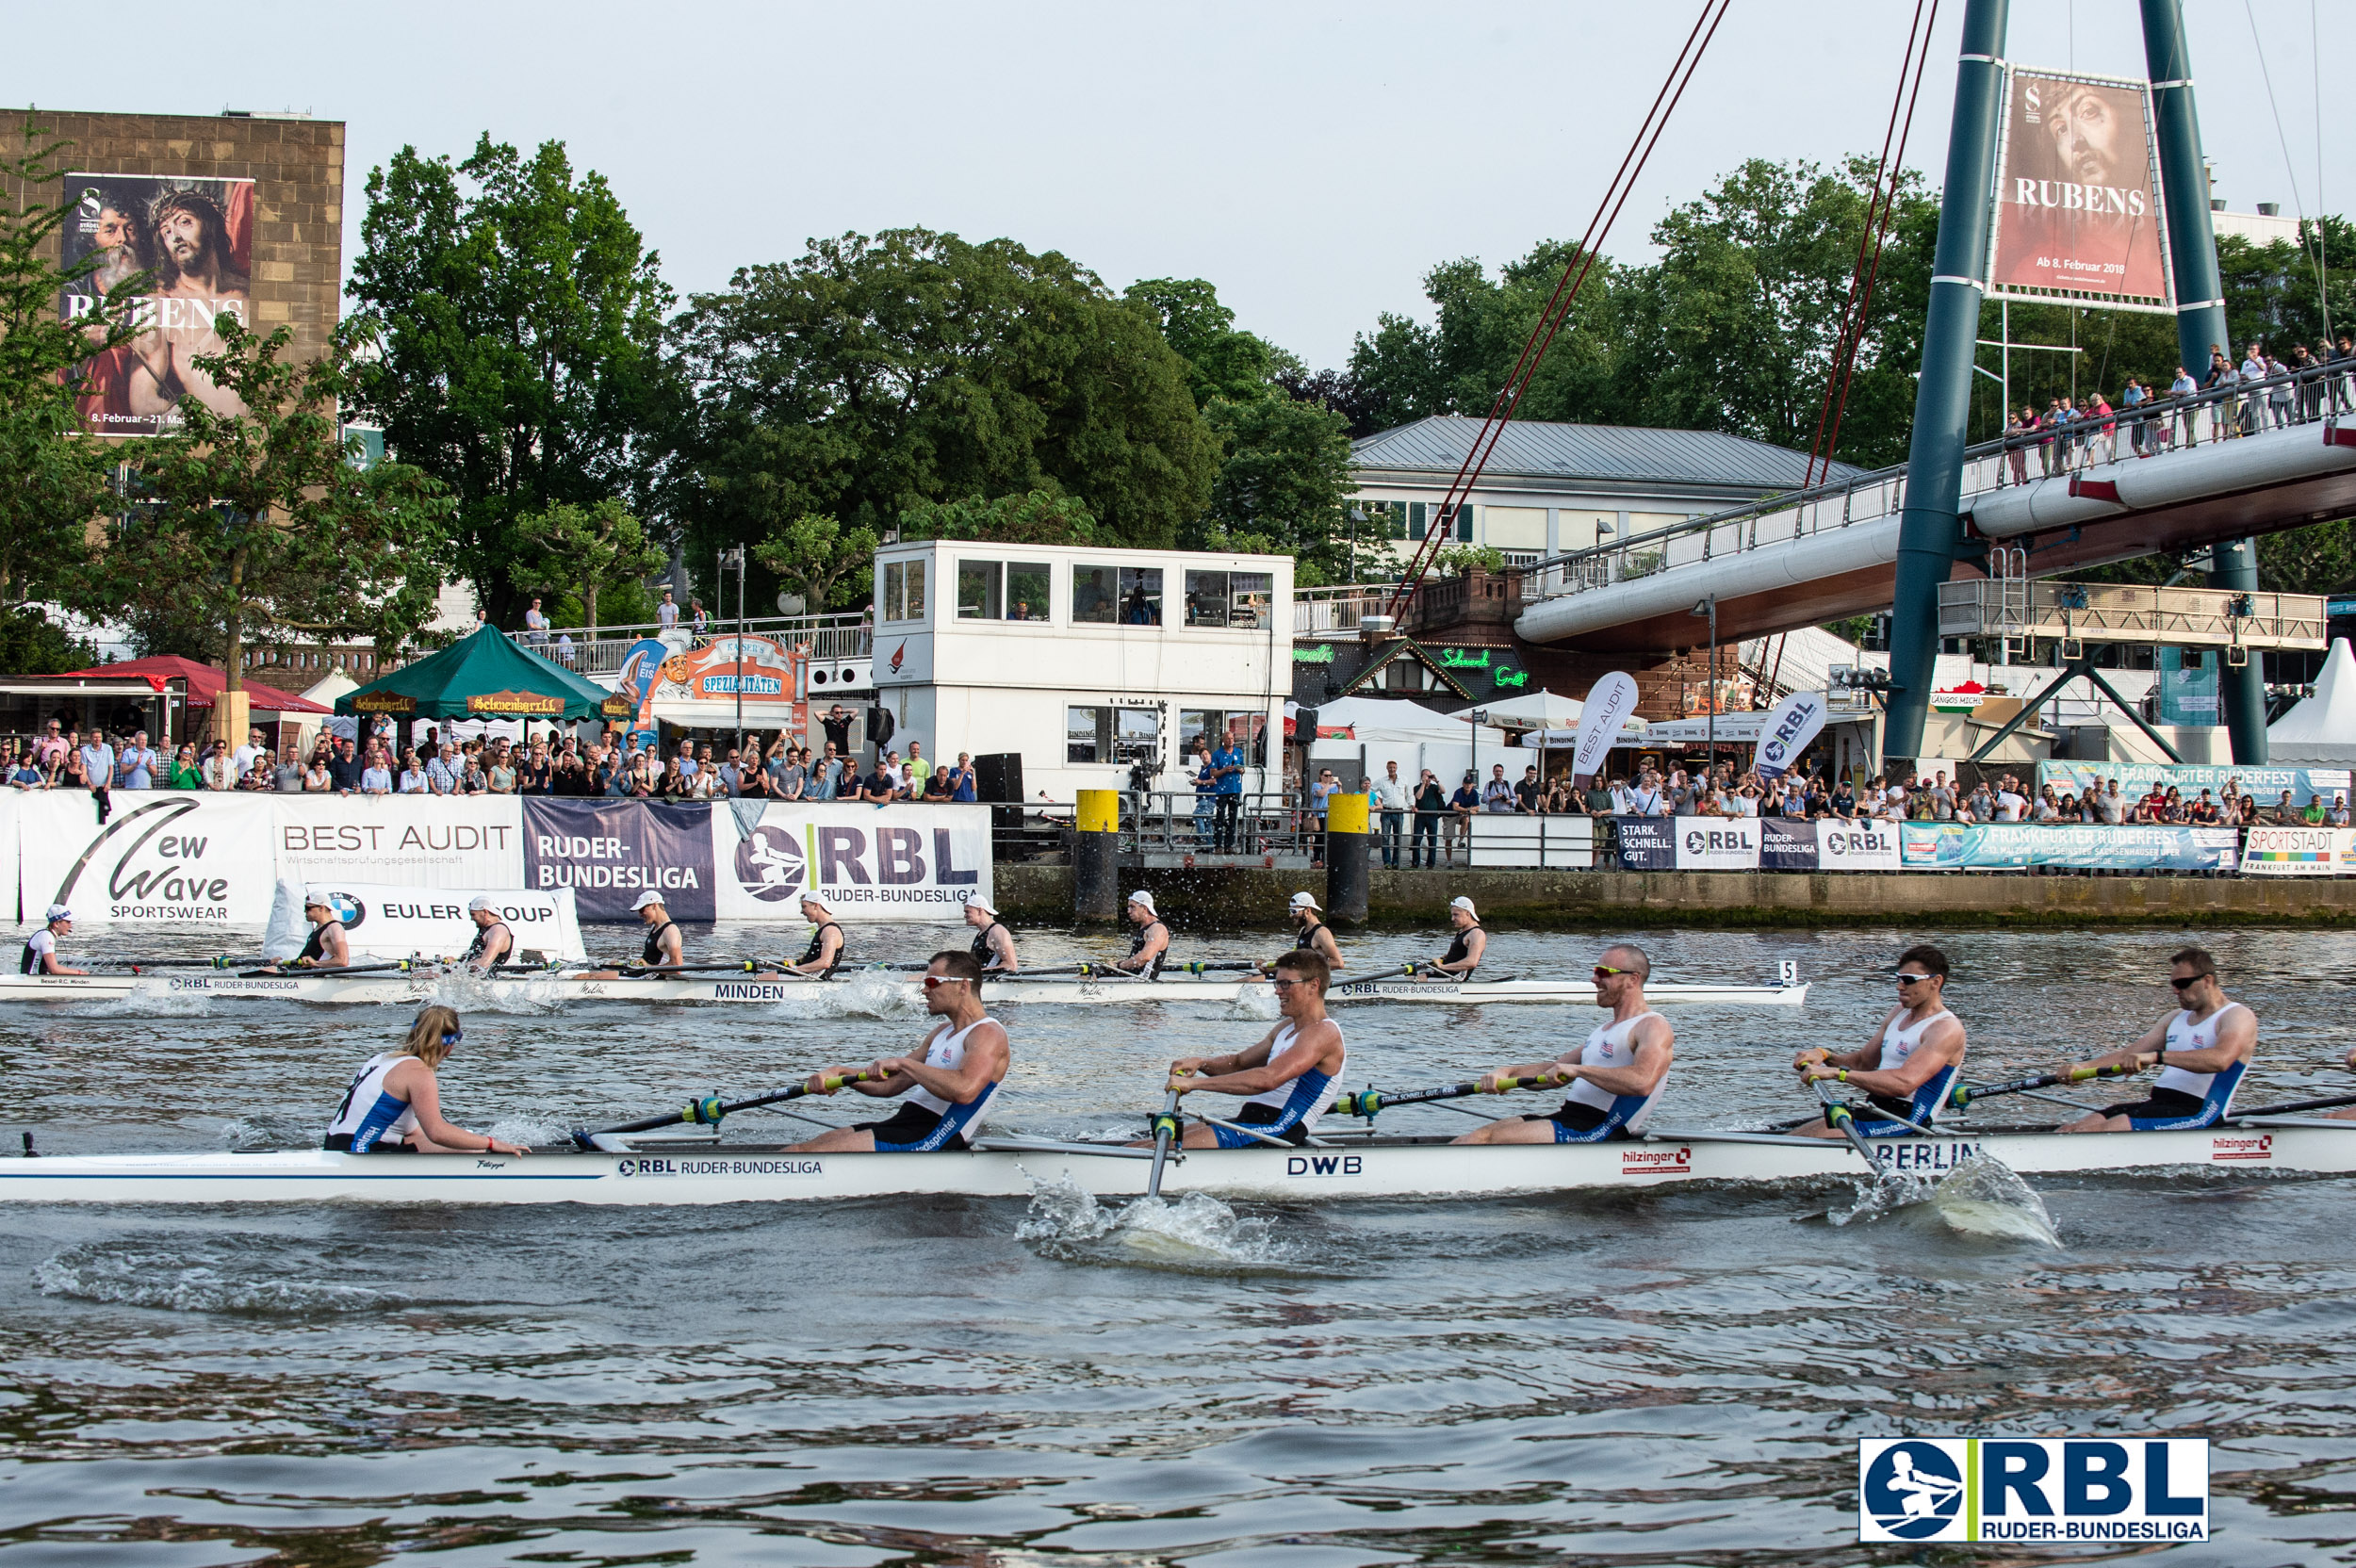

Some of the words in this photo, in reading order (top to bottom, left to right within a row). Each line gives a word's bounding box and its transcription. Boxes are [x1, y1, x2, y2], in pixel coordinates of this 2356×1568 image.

[2015, 177, 2145, 216] RUBENS
[2036, 256, 2050, 267] Ab
[2053, 258, 2062, 268] 8.
[2064, 259, 2102, 272] Februar
[2103, 263, 2125, 274] 2018
[91, 413, 101, 423] 8.
[727, 643, 765, 654] KASER'S
[641, 661, 656, 670] SOFT
[639, 669, 654, 679] EIS
[704, 676, 781, 694] SPEZIALITÄTEN
[1960, 696, 1982, 704] MICHL
[1578, 725, 1602, 765] BEST
[1600, 680, 1625, 725] AUDIT
[1775, 702, 1814, 742] RBL
[1549, 736, 1576, 744] BINDING
[2120, 768, 2214, 783] FRANKFURTER
[2218, 770, 2296, 784] RUDERFEST
[1622, 825, 1658, 836] STARK.
[1990, 829, 2094, 845] FRANKFURTER
[2098, 830, 2178, 845] RUDERFEST
[284, 825, 384, 851] BEST
[399, 825, 512, 850] AUDIT
[1624, 838, 1671, 849] SCHNELL.
[1709, 831, 1753, 849] RBL
[1764, 834, 1794, 842] RUDER-
[1849, 833, 1891, 850] RBL
[2250, 831, 2333, 849] SPORTSTADT
[538, 835, 631, 859] RUDER-
[1764, 844, 1816, 853] BUNDESLIGA
[2161, 849, 2180, 857] UFER
[286, 856, 463, 865] Wirtschaftsprüfungsgesellschaft
[818, 826, 978, 885] RBL
[1624, 851, 1647, 861] GUT.
[2245, 863, 2290, 871] FRANKFURT
[539, 865, 699, 889] BUNDESLIGA
[110, 906, 228, 919] SPORTSWEAR
[383, 903, 462, 919] EULER
[496, 906, 553, 923] OUP
[1785, 962, 1792, 979] 5
[184, 979, 212, 988] RBL
[214, 981, 299, 989] RUDER-BUNDESLIGA
[1355, 984, 1380, 993] RBL
[715, 984, 784, 999] MINDEN
[1382, 1095, 1400, 1103] STARK.
[1400, 1092, 1425, 1100] SCHNELL.
[2213, 1138, 2258, 1151] hilzinger
[1623, 1151, 1674, 1165] hilzinger
[639, 1160, 676, 1173] RBL
[682, 1161, 822, 1174] RUDER-BUNDESLIGA
[1287, 1156, 1362, 1175] DWB
